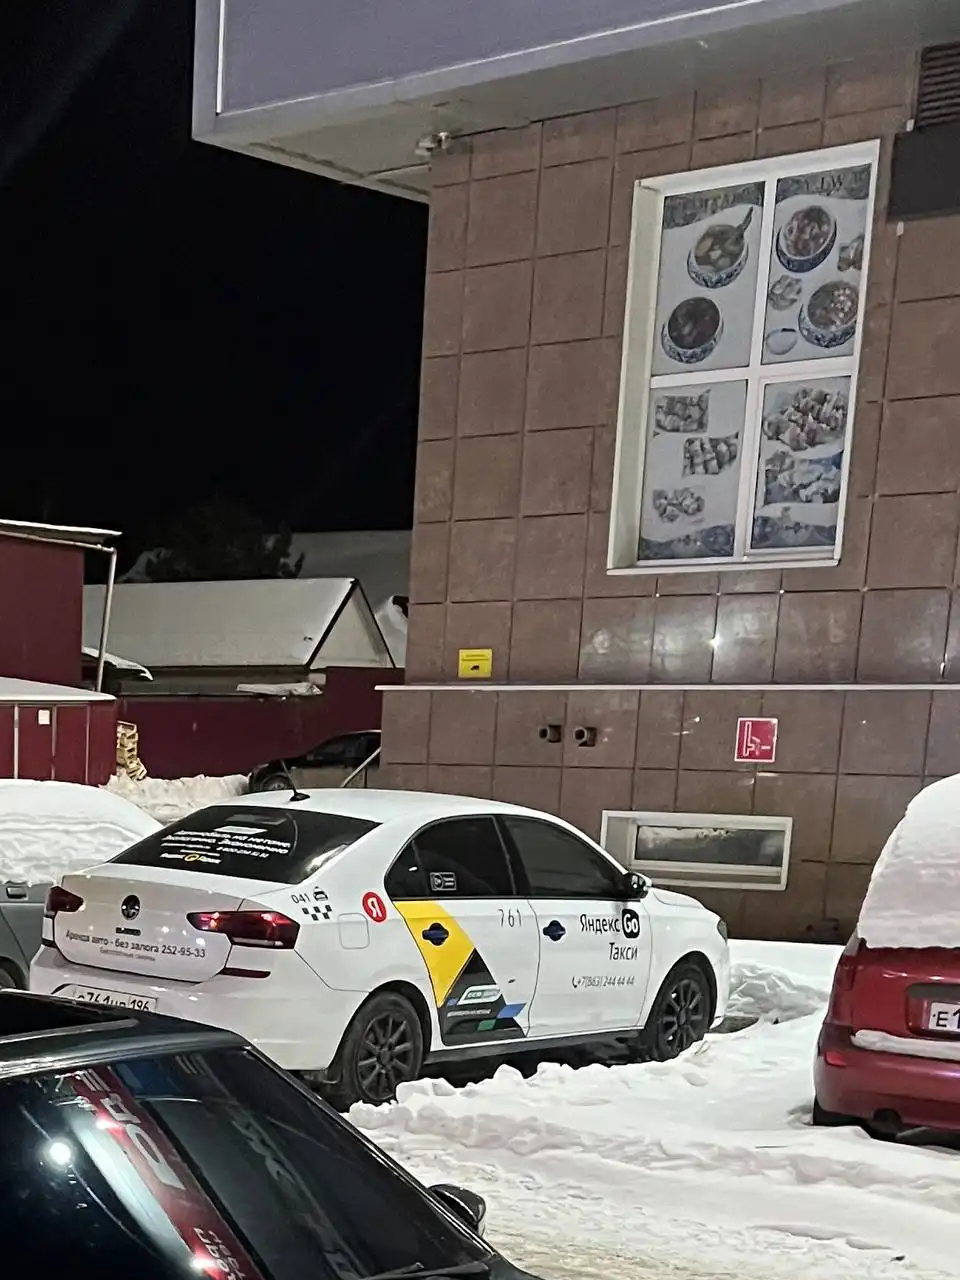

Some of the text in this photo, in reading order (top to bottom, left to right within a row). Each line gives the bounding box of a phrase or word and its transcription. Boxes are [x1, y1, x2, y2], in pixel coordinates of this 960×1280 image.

[291, 893, 311, 904] 041
[498, 908, 522, 928] 761
[580, 912, 640, 935] Яндекс Go
[115, 938, 129, 949] без
[161, 944, 206, 958] 252-95-33
[609, 942, 638, 960] Такси
